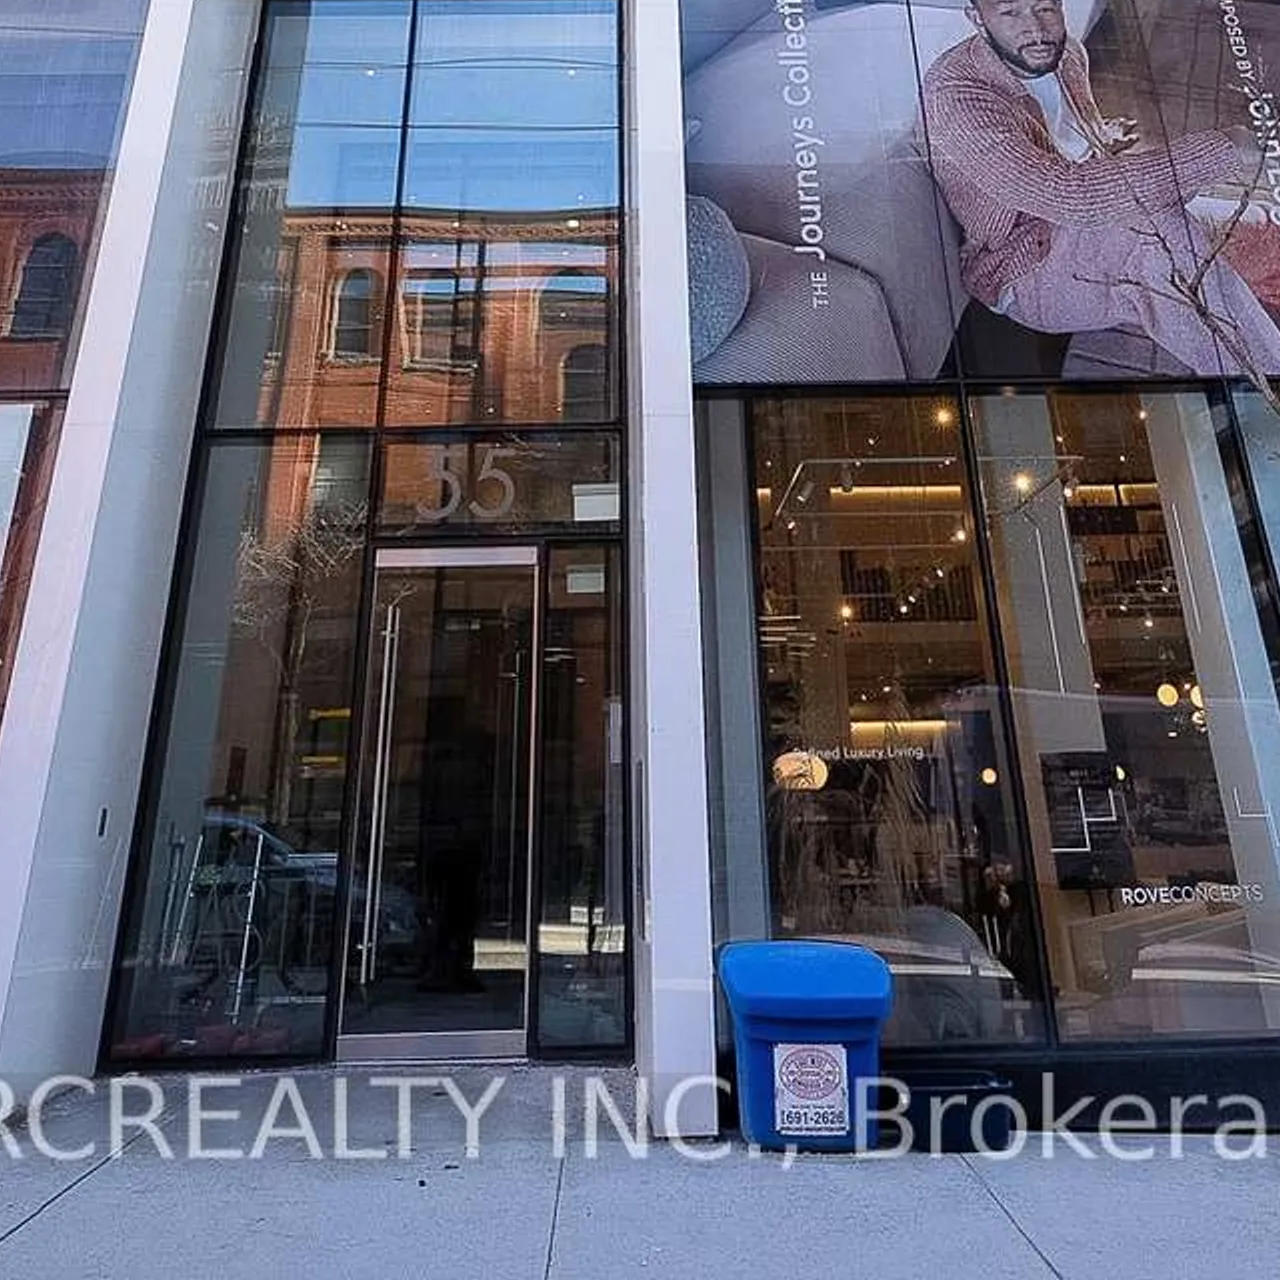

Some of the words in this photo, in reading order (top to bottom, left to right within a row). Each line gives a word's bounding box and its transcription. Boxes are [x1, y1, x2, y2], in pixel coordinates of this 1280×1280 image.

[1236, 58, 1256, 81] BY
[794, 115, 825, 261] Journeys
[810, 271, 830, 308] THE
[417, 444, 516, 519] 55
[842, 746, 886, 761] Luxury
[887, 745, 925, 760] Living
[1121, 883, 1265, 905] ROVECONCEPTS
